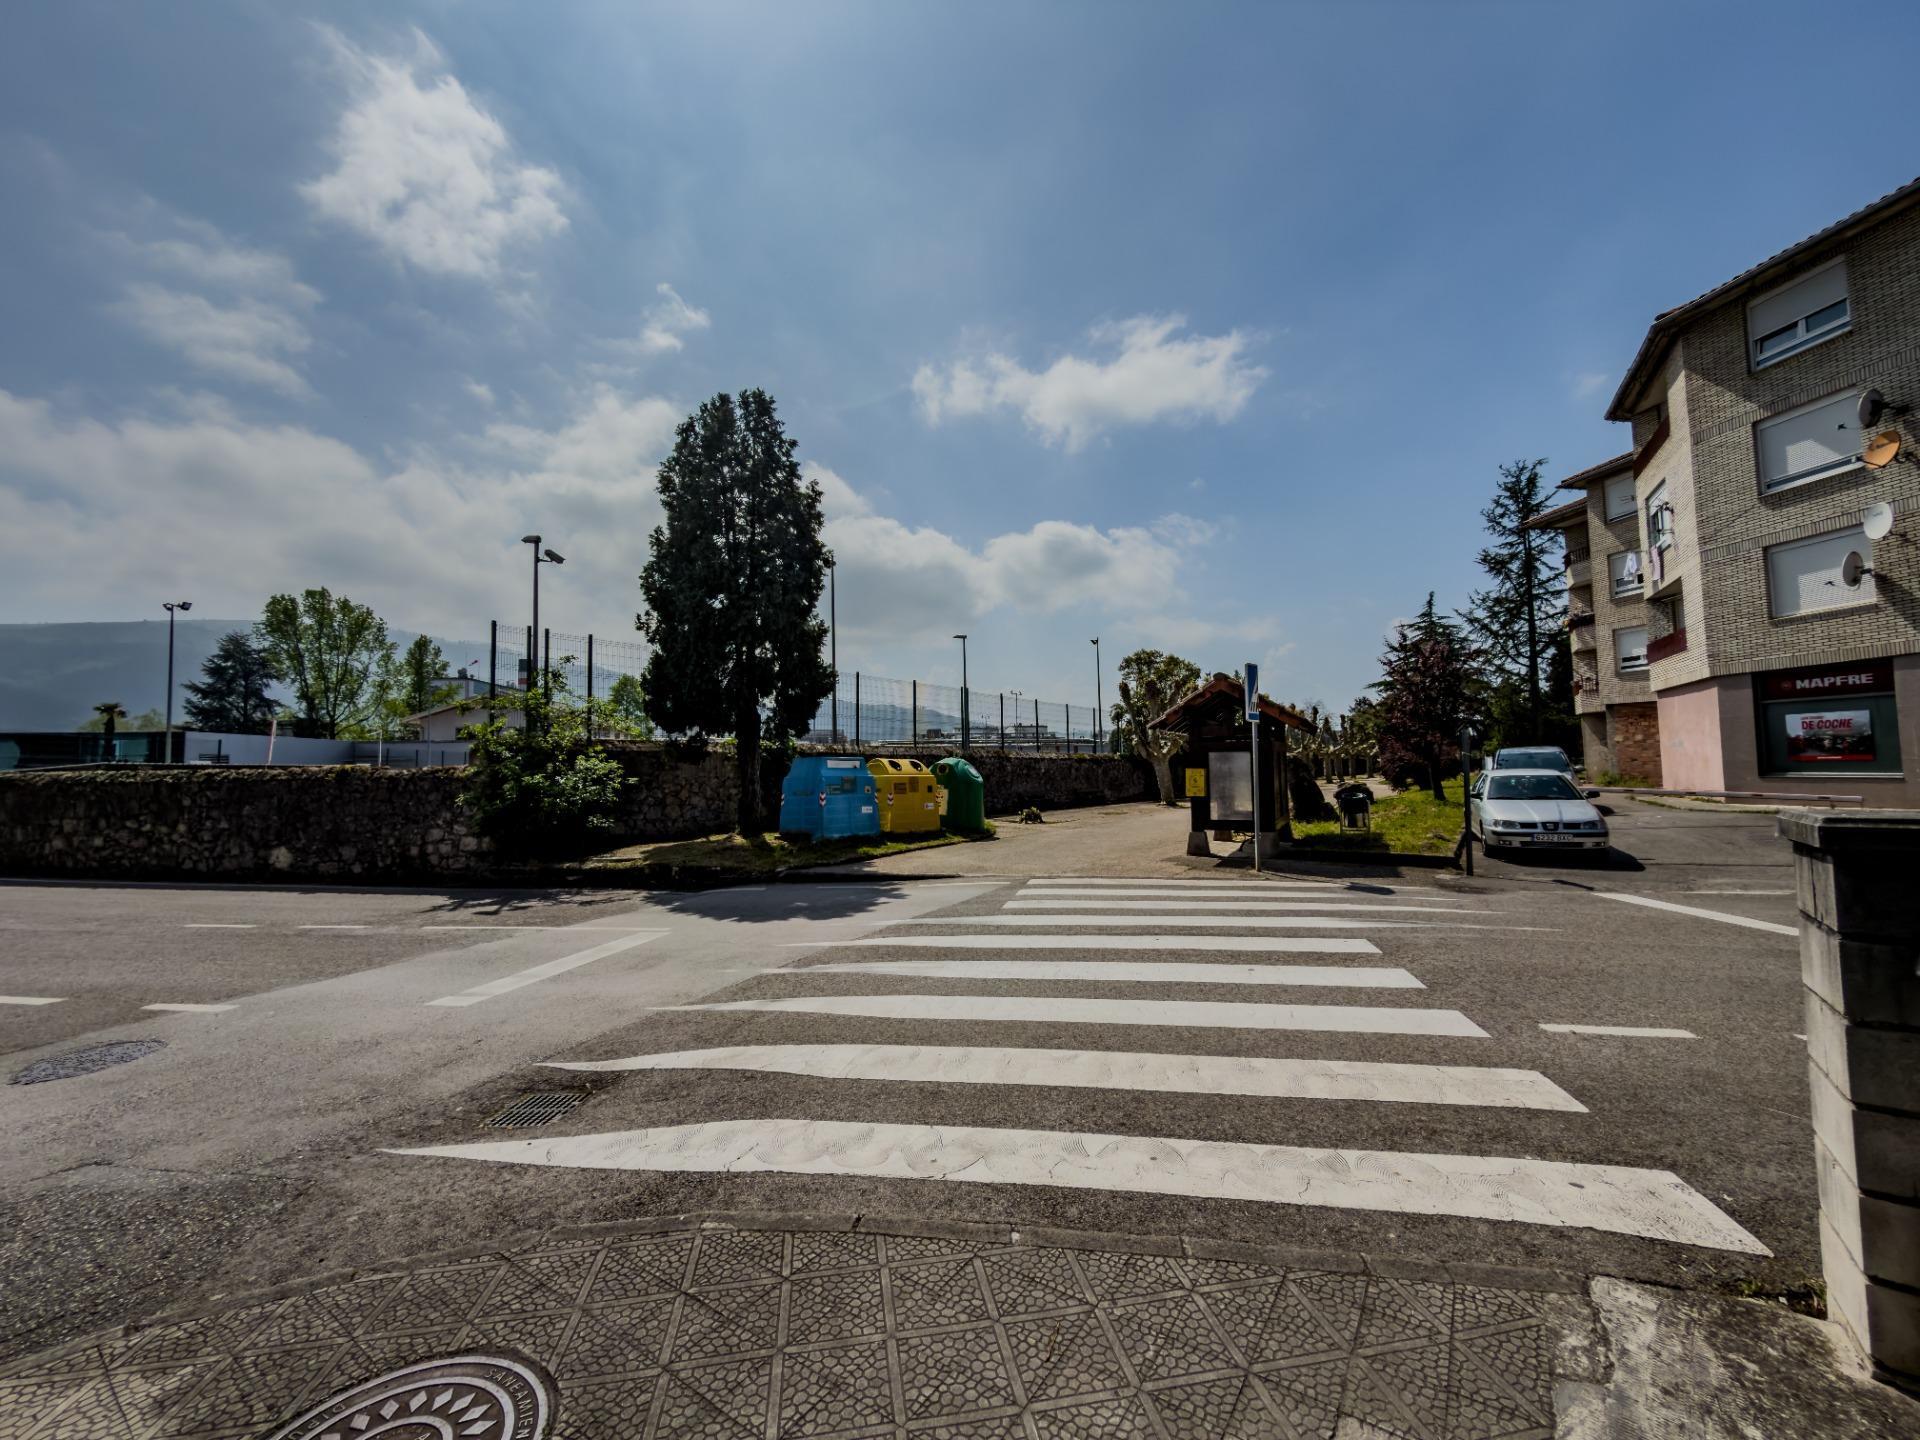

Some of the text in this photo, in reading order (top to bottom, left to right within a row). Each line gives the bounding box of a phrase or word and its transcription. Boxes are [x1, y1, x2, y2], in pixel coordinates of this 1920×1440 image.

[1795, 673, 1874, 690] MAPFRE
[1801, 718, 1853, 730] DE COCHE
